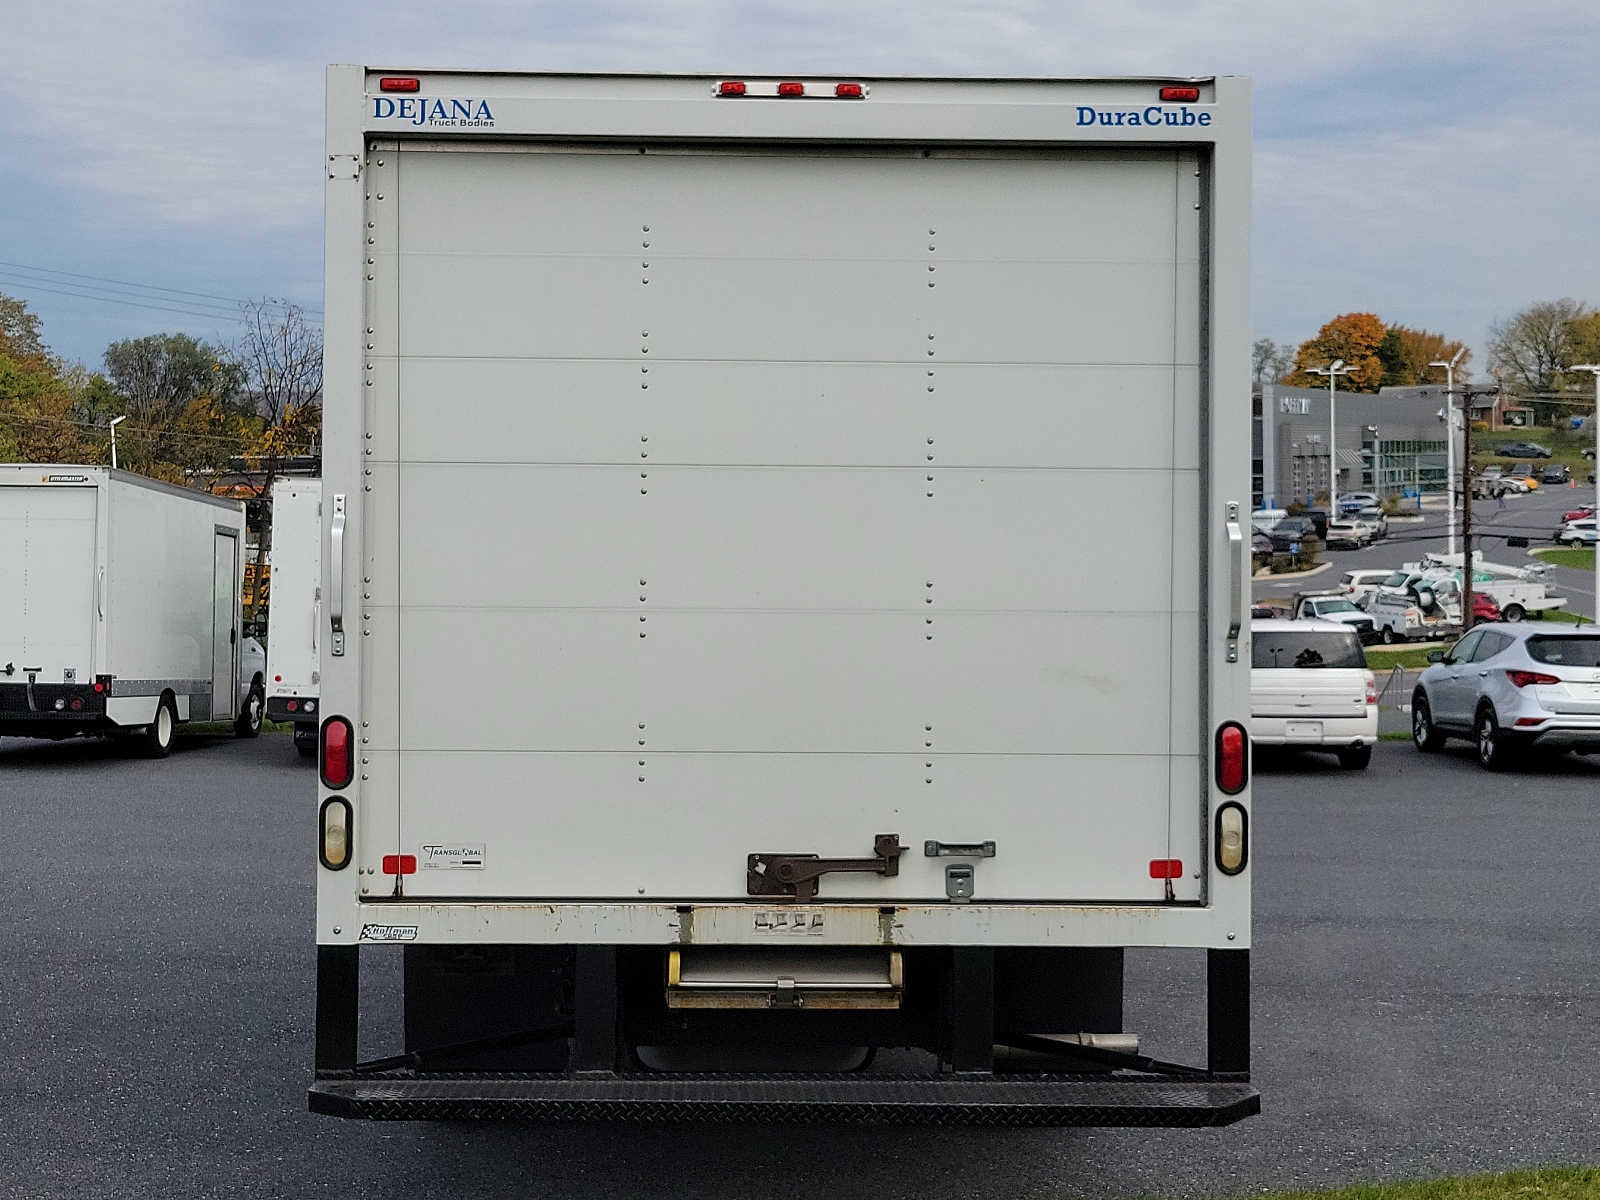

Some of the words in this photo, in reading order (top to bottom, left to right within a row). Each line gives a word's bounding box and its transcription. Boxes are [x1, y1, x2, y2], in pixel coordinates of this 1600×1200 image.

[373, 97, 495, 126] DEJANA
[1076, 106, 1212, 126] DuraCube
[429, 119, 457, 127] Truck
[460, 119, 495, 128] Bodies
